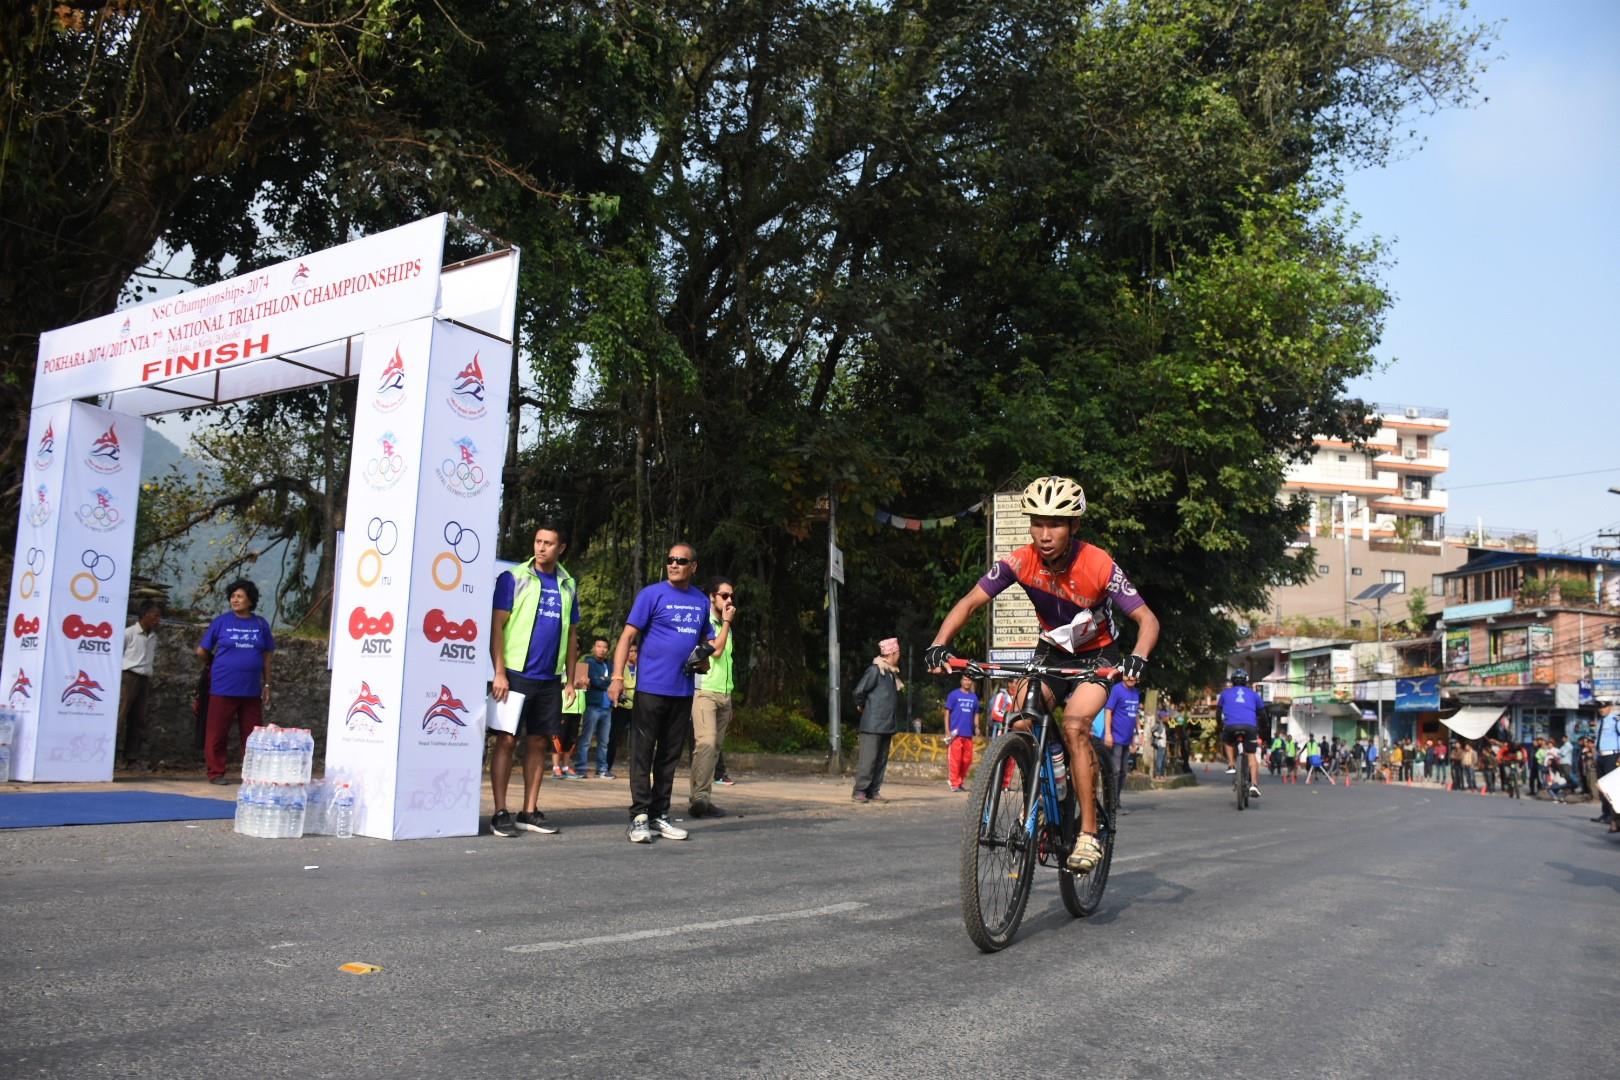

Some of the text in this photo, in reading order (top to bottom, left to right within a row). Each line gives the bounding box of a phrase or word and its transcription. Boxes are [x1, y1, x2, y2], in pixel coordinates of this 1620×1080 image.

[151, 274, 270, 321] NSC Championships 2074
[43, 352, 87, 375] POKHARA
[87, 340, 128, 364] 2074/2017
[128, 334, 150, 354] NTA
[167, 313, 225, 343] NATIONAL
[227, 292, 304, 327] TRIATHLON
[304, 257, 422, 308] CHAMPIONSHIPS
[141, 333, 269, 382] FINISH
[462, 584, 474, 594] ITU
[98, 595, 110, 604] ITU
[20, 636, 39, 648] ASTC
[77, 639, 111, 653] ASTC
[361, 638, 392, 654] ASTC
[440, 642, 476, 661] ASTC
